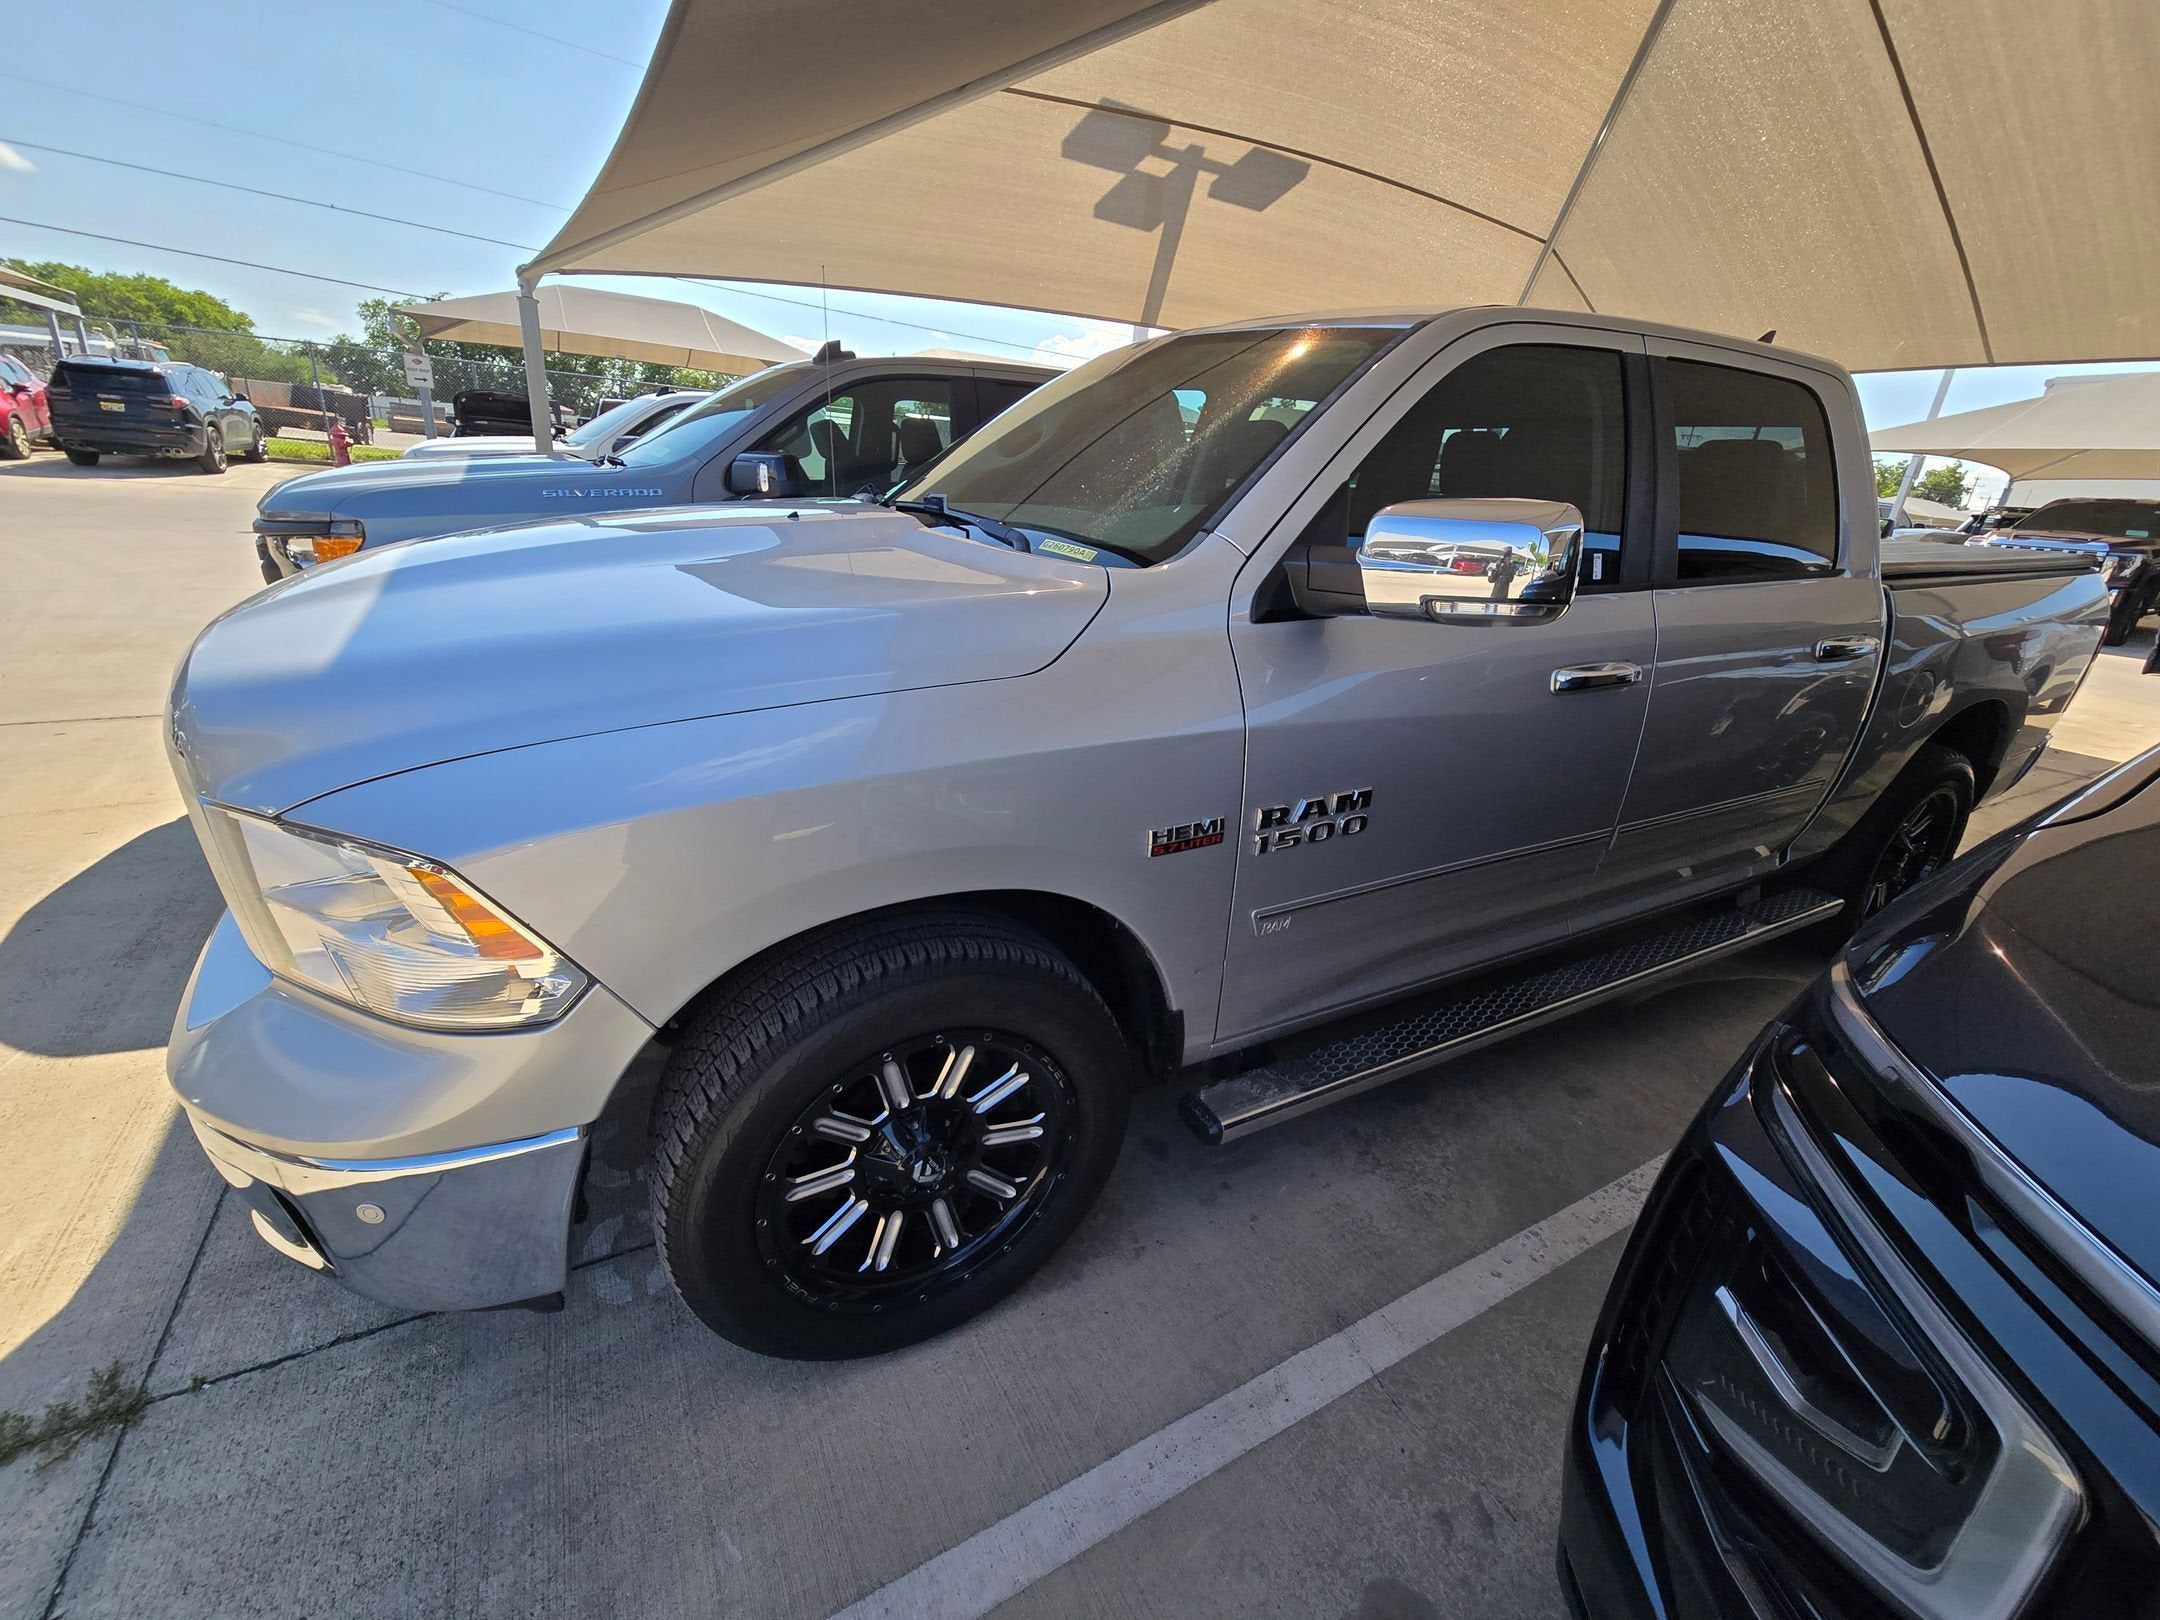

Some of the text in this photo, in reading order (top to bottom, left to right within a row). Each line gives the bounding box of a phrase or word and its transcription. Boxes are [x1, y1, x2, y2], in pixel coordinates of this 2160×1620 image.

[542, 488, 663, 498] SILVERADO
[1255, 786, 1373, 832] RAM
[1147, 816, 1225, 845] HEMI
[1180, 834, 1222, 850] LITER
[1253, 813, 1368, 857] 1500
[1260, 916, 1291, 936] RAM
[1040, 1055, 1065, 1089] FUEL
